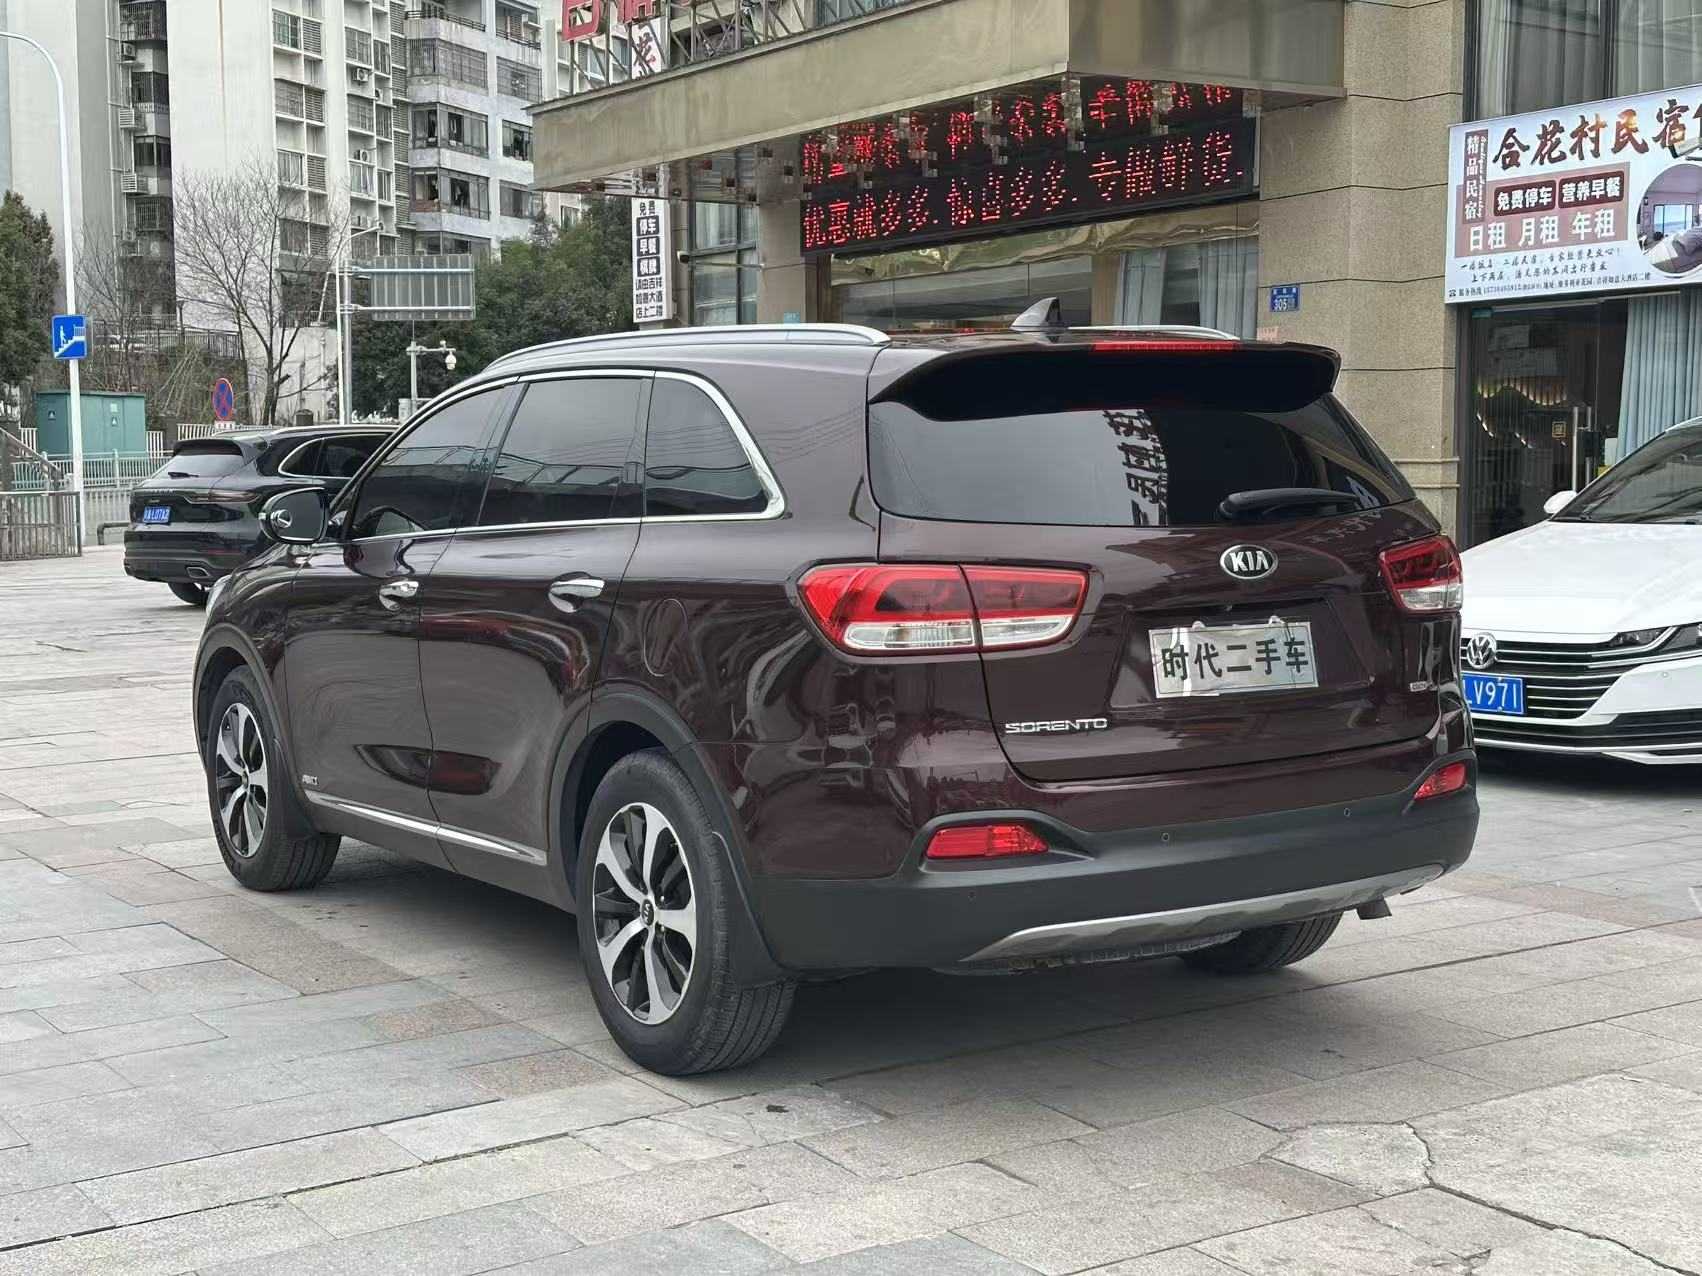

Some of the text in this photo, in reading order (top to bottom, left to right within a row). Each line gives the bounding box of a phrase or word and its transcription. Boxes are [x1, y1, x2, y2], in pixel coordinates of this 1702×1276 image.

[1492, 98, 1702, 171] 合花村民宿
[1497, 176, 1621, 211] 免费停车 营养早餐
[1470, 208, 1616, 252] 日租 月租 年租
[1229, 550, 1270, 572] KIA
[1161, 637, 1309, 681] 时代二手车
[1005, 718, 1108, 734] SORENTO
